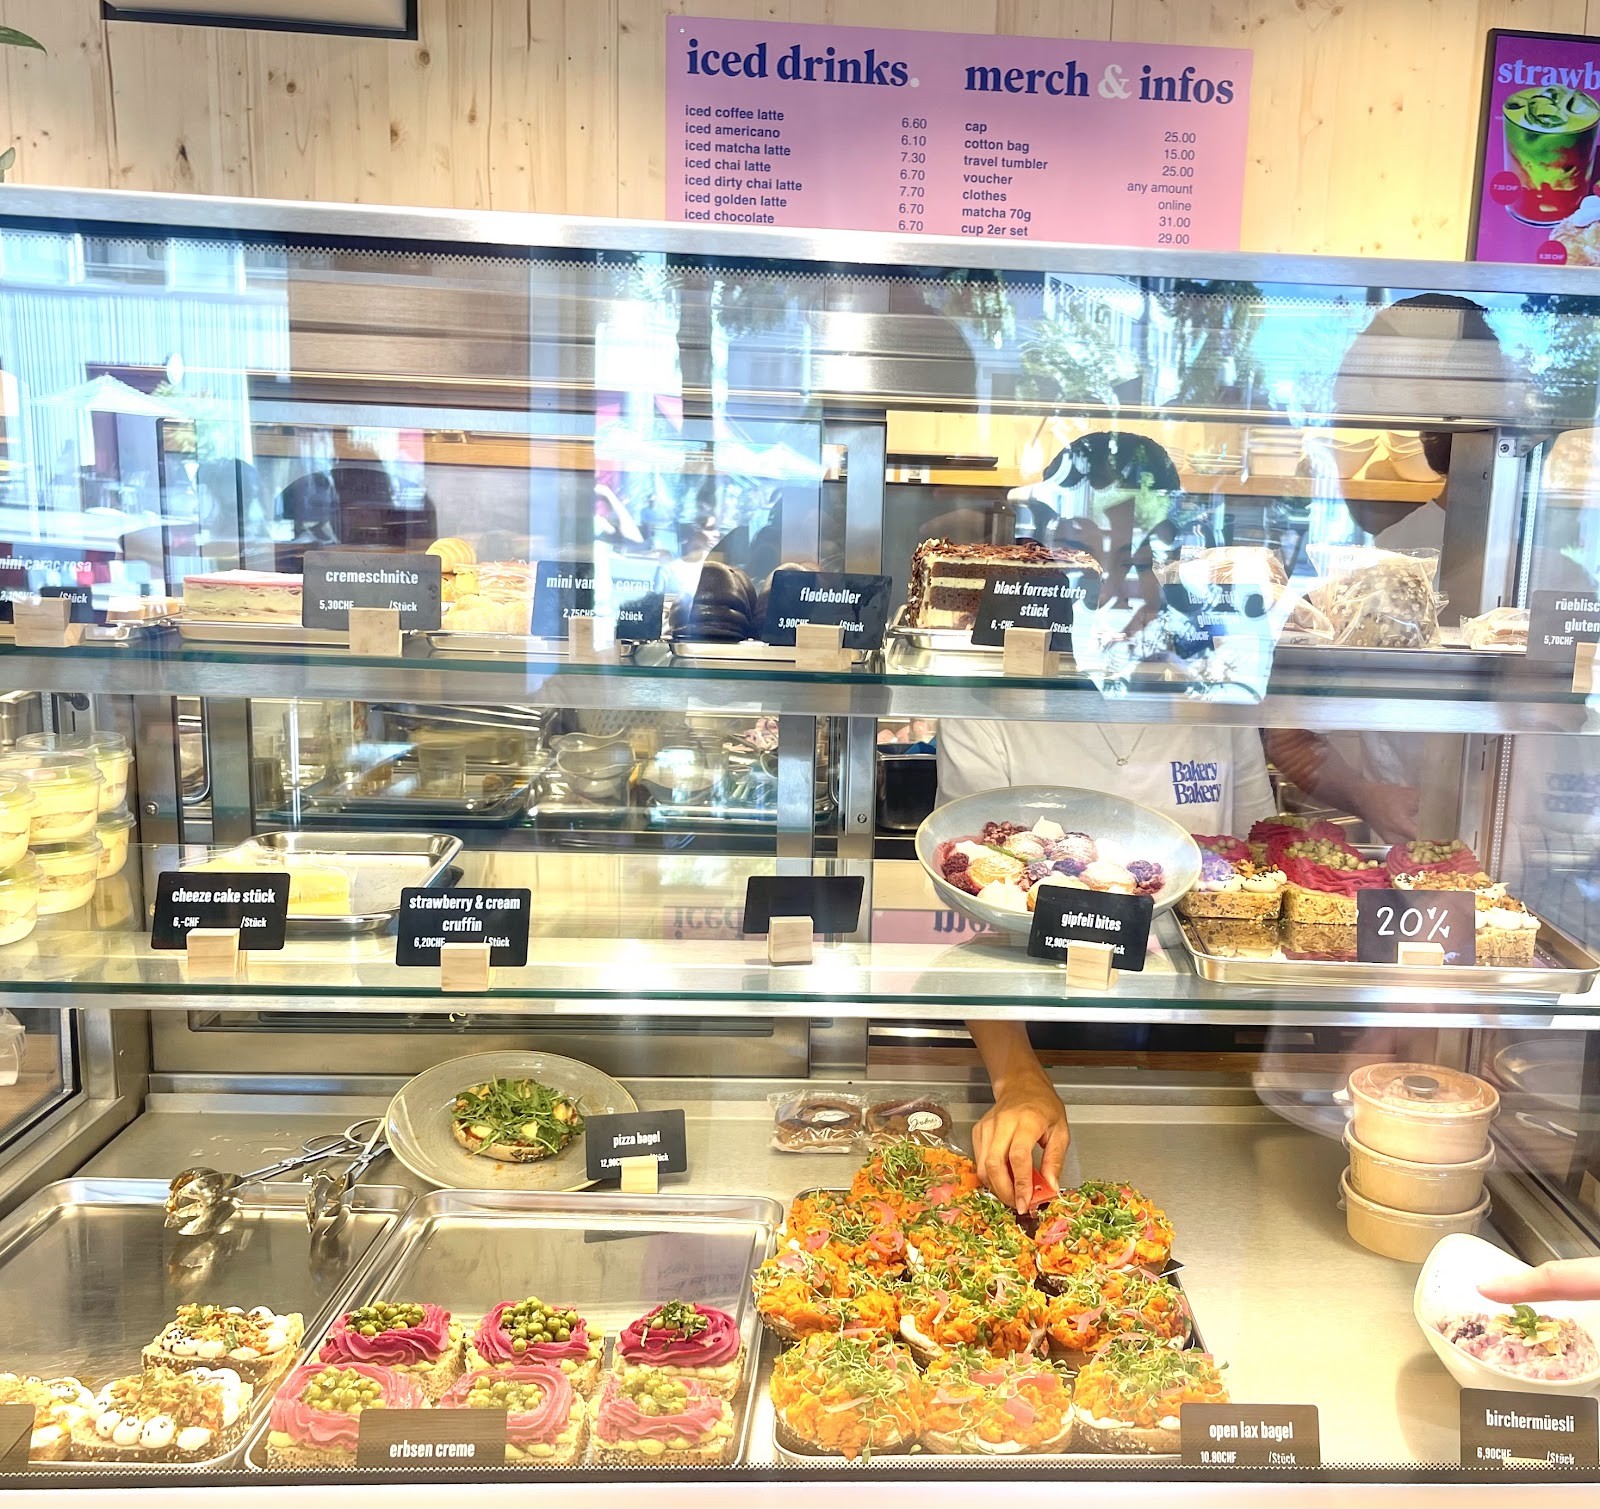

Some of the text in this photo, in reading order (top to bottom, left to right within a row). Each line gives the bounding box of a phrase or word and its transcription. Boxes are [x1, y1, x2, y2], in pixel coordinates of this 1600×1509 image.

[687, 38, 920, 87] iced drinks.
[964, 60, 1234, 105] merch & infos
[1497, 59, 1600, 91] strawb
[685, 105, 927, 130] iced coffee latte 6.60
[685, 122, 927, 147] iced americano 6.10
[965, 122, 1196, 144] cap 25.00
[685, 140, 926, 164] iced matcha latte 7.30
[964, 138, 1195, 161] cotton bag 15.00
[685, 157, 925, 181] iced chai latte 6.70
[963, 155, 1194, 178] travel tumbler 25.00
[685, 175, 925, 198] iced dirty chai latte 7.70
[963, 172, 1193, 195] voucher any amount
[685, 192, 924, 215] iced golden latte 6.70
[962, 189, 1191, 212] clothes online
[684, 209, 924, 232] iced chocolate 6.70
[962, 207, 1191, 228] matcha 70g 31.00
[961, 224, 1190, 245] cup 2er set 29.00
[24, 559, 60, 571] carac
[546, 574, 572, 588] mini
[994, 580, 1087, 600] black forrest torte
[319, 599, 418, 612] 5,30CHF /Stück
[800, 587, 861, 605] flødeboller
[1020, 603, 1050, 618] stück
[1565, 618, 1600, 633] gluten
[1543, 635, 1574, 646] 5,70CHF
[1169, 760, 1217, 783] Bakery
[1172, 782, 1221, 806] Bakery
[172, 887, 276, 904] cheeze cake stück
[409, 894, 521, 912] strawberry & cream
[172, 916, 267, 928] 6,-CHF /Stück
[442, 917, 482, 932] cruffin
[1061, 911, 1122, 931] gipfeli bites
[1376, 906, 1451, 941] 20%
[414, 937, 446, 949] 6,20CHF
[1045, 936, 1072, 949] 12,90C
[613, 1130, 661, 1148] pizza bagel
[1209, 1420, 1294, 1442] open lax bagel
[1485, 1408, 1575, 1433] birchermüesli
[389, 1439, 476, 1458] erbsen creme
[1268, 1450, 1296, 1465] /Stück
[1476, 1446, 1575, 1465] 6,90CHF /Stück
